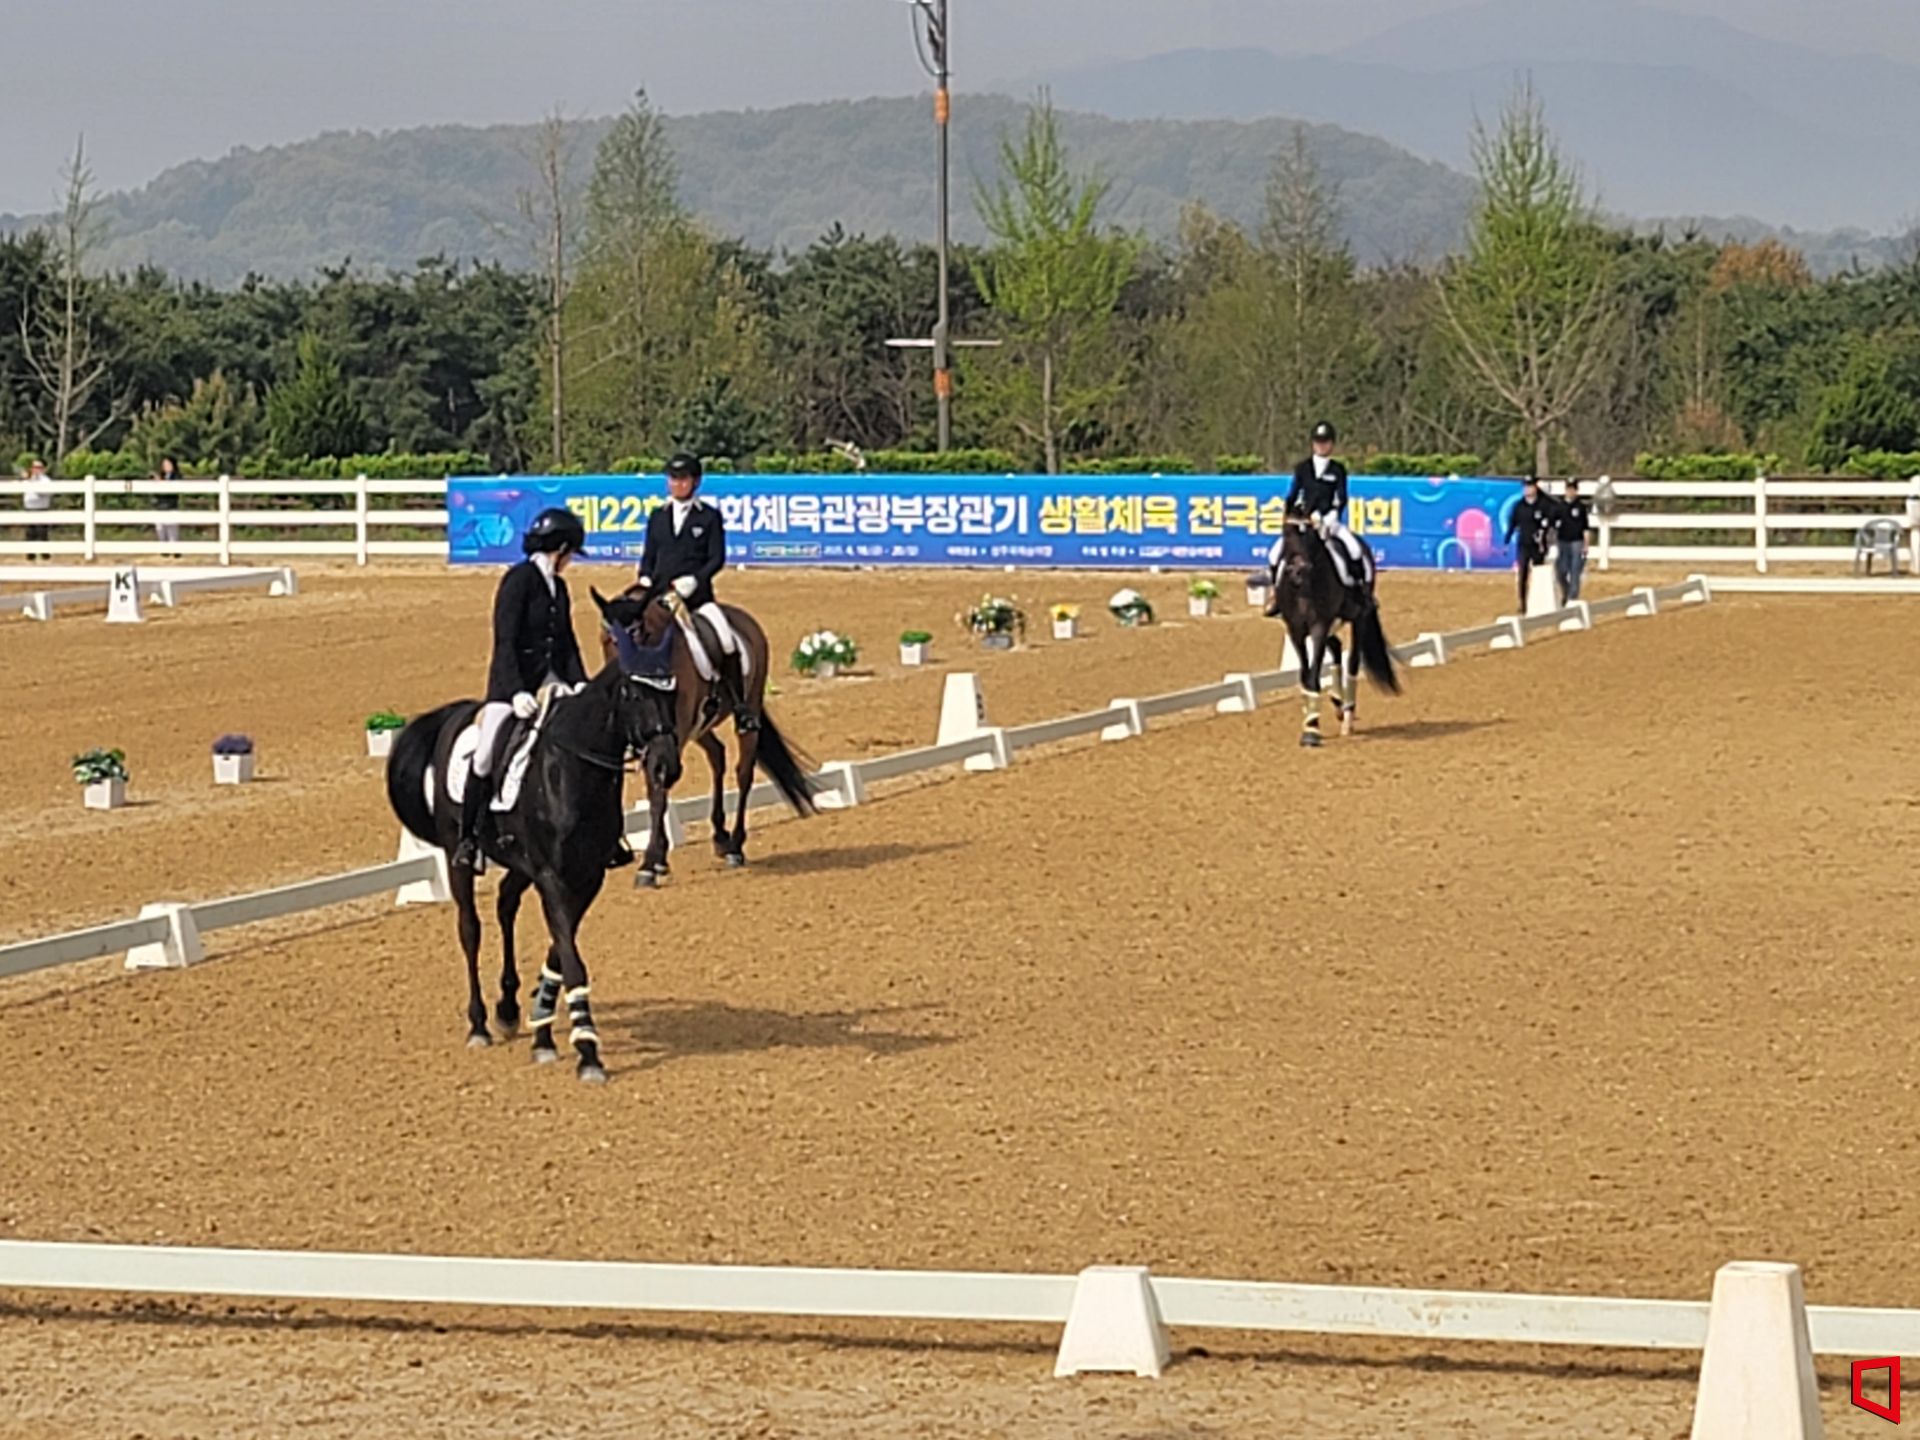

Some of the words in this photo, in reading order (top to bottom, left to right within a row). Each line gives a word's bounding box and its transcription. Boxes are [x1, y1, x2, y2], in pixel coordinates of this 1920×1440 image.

[566, 496, 665, 533] 제22
[699, 495, 1028, 534] 화체육관광부장관기
[1039, 496, 1178, 534] 생활체육
[1188, 496, 1401, 535] 전국승회
[115, 571, 131, 590] K
